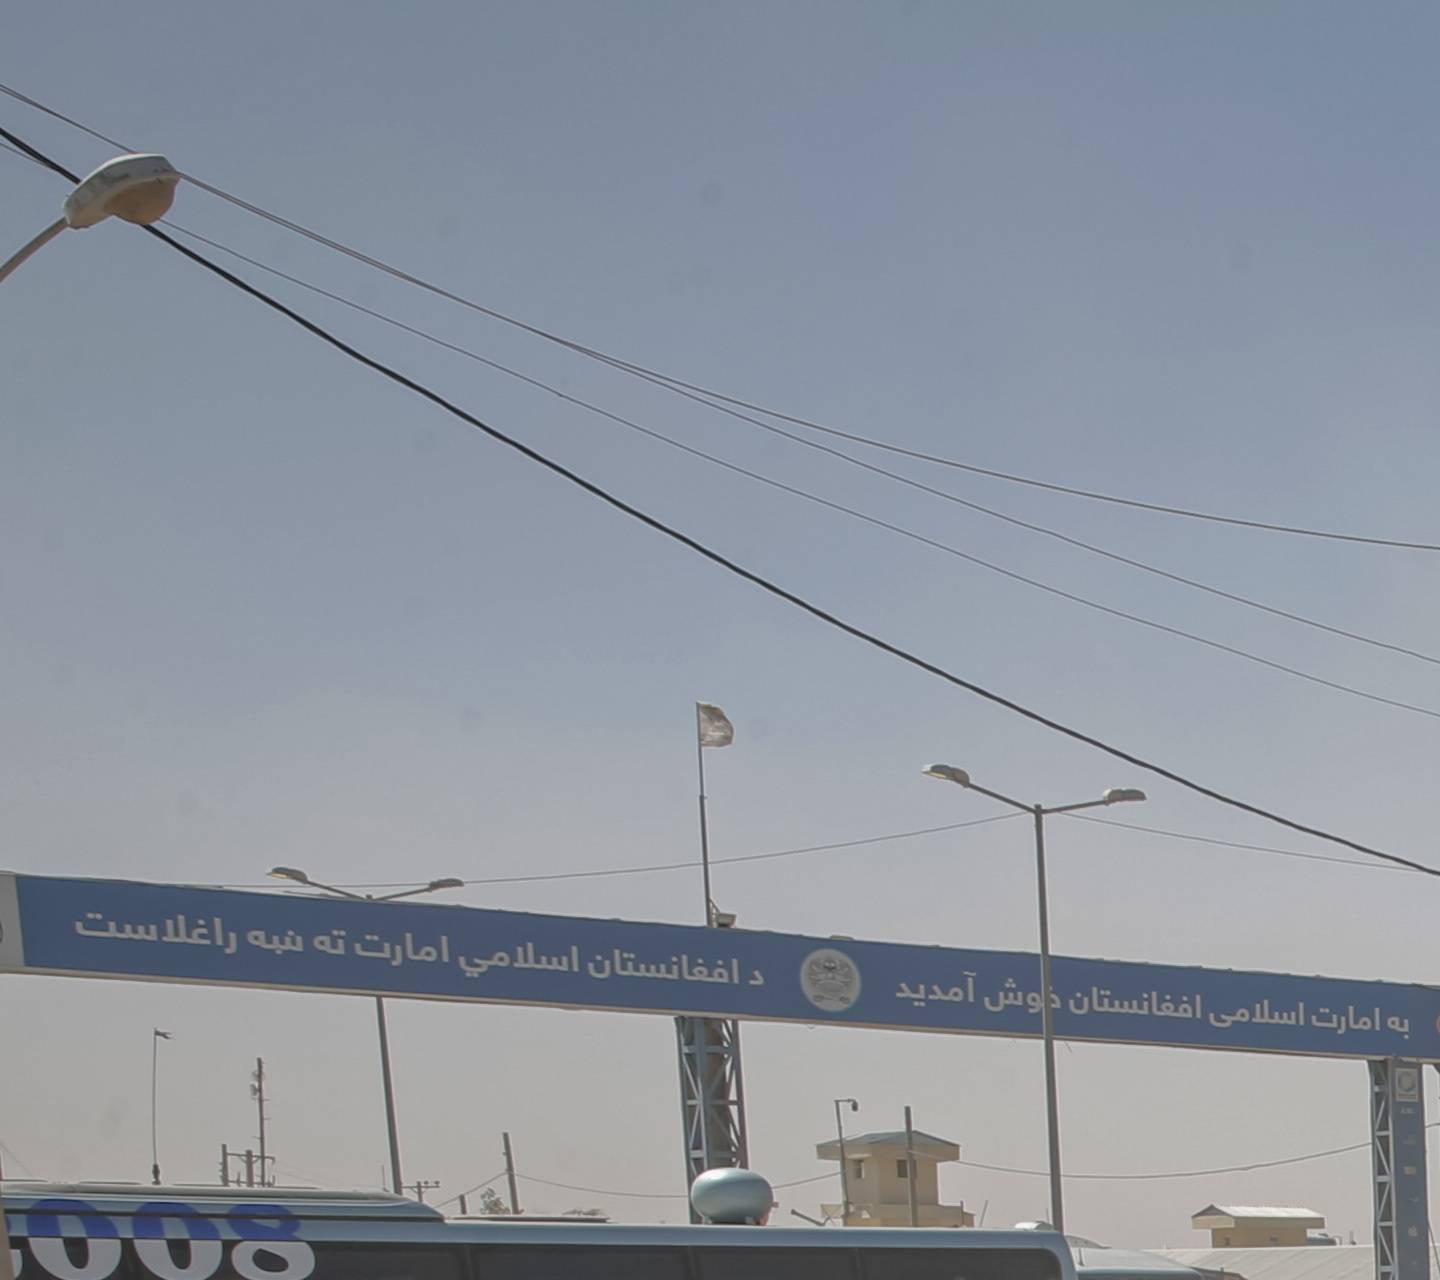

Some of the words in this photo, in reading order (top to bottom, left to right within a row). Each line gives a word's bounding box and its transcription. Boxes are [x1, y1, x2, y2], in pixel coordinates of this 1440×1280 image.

[75, 912, 237, 955] راغلاست
[313, 930, 346, 955] ته
[355, 934, 449, 967] امارت
[588, 949, 739, 985] افغانستان
[749, 970, 764, 986] د
[894, 971, 977, 1007] آمدید
[1069, 987, 1201, 1019] افغانستان
[1311, 1005, 1381, 1035] امارت
[1387, 1016, 1410, 1040] به
